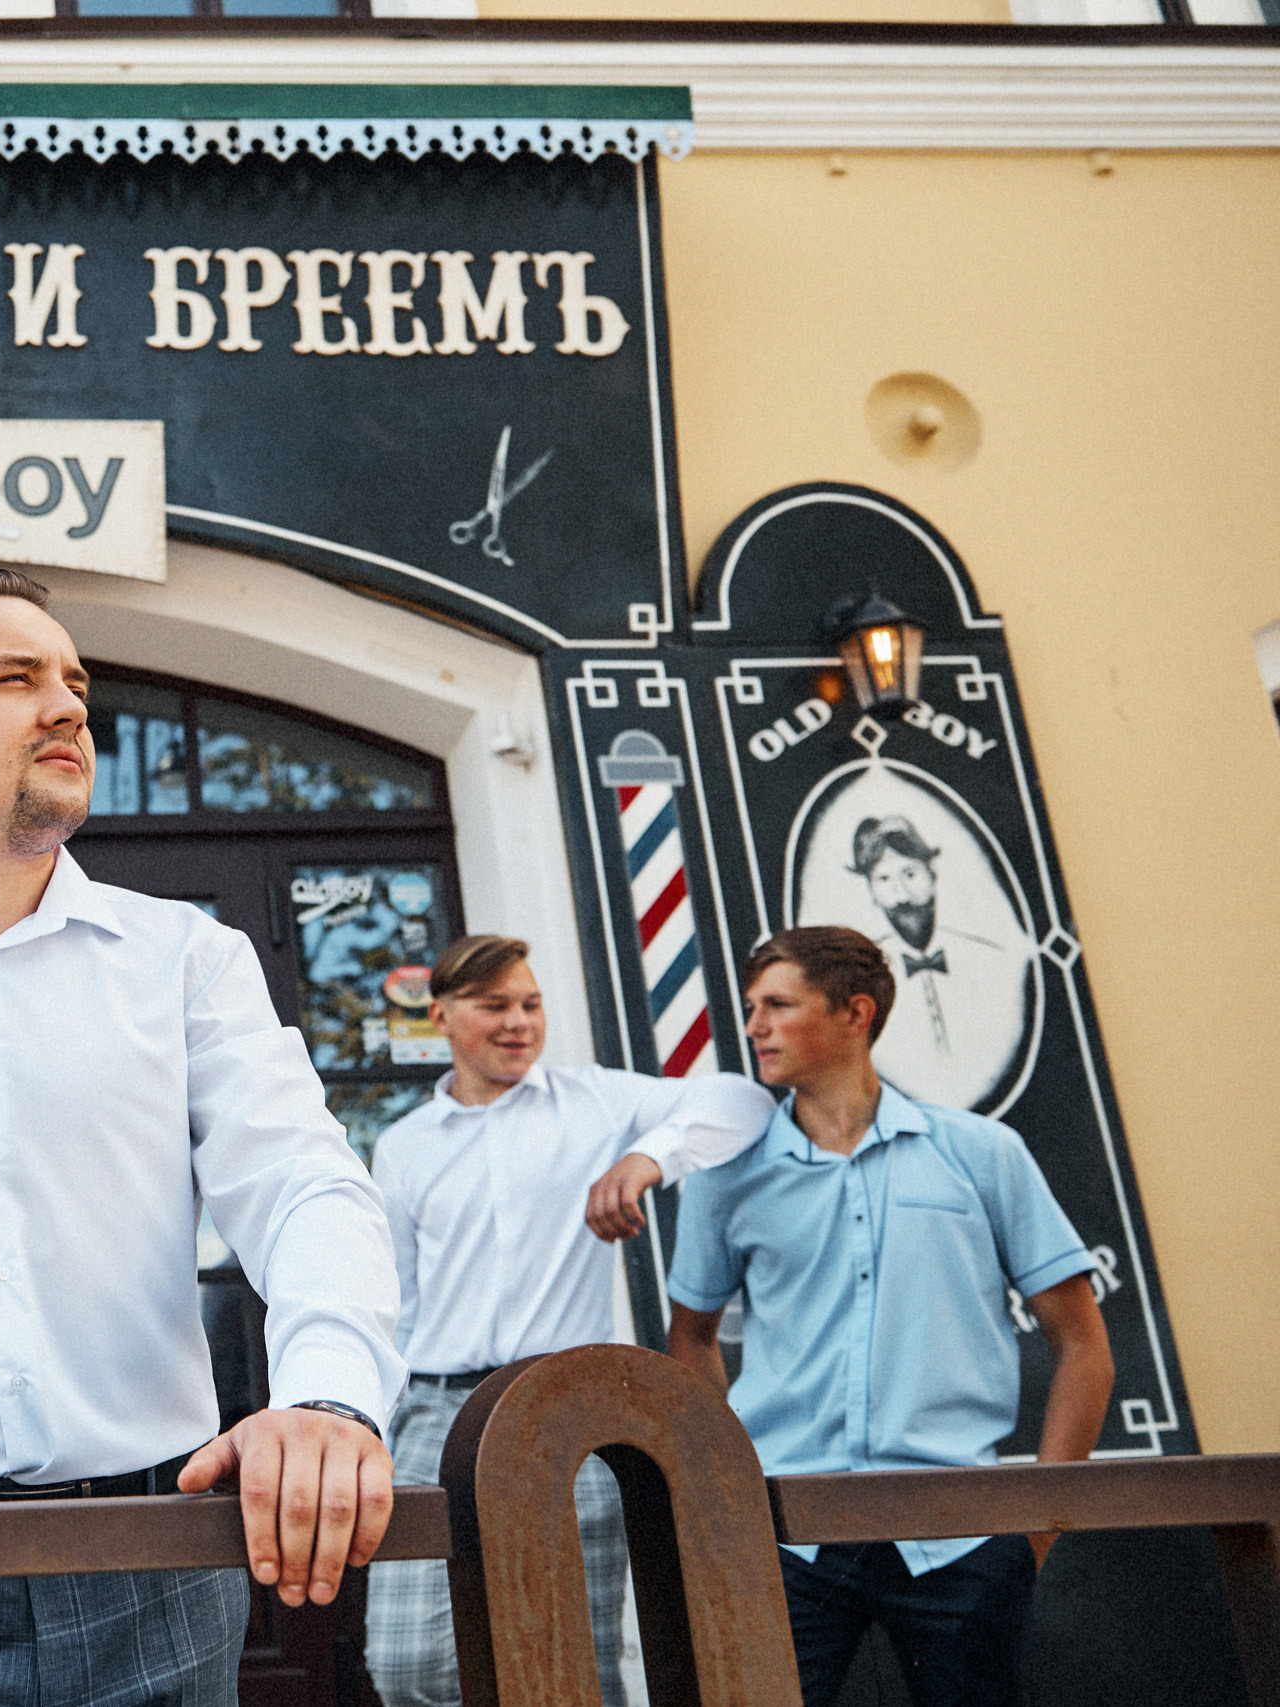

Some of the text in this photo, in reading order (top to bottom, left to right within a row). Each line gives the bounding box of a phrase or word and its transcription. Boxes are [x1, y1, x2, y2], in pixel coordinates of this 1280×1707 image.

[4, 243, 88, 348] И
[143, 246, 631, 357] БРЕЕМЪ
[748, 698, 998, 762] OLD BOY
